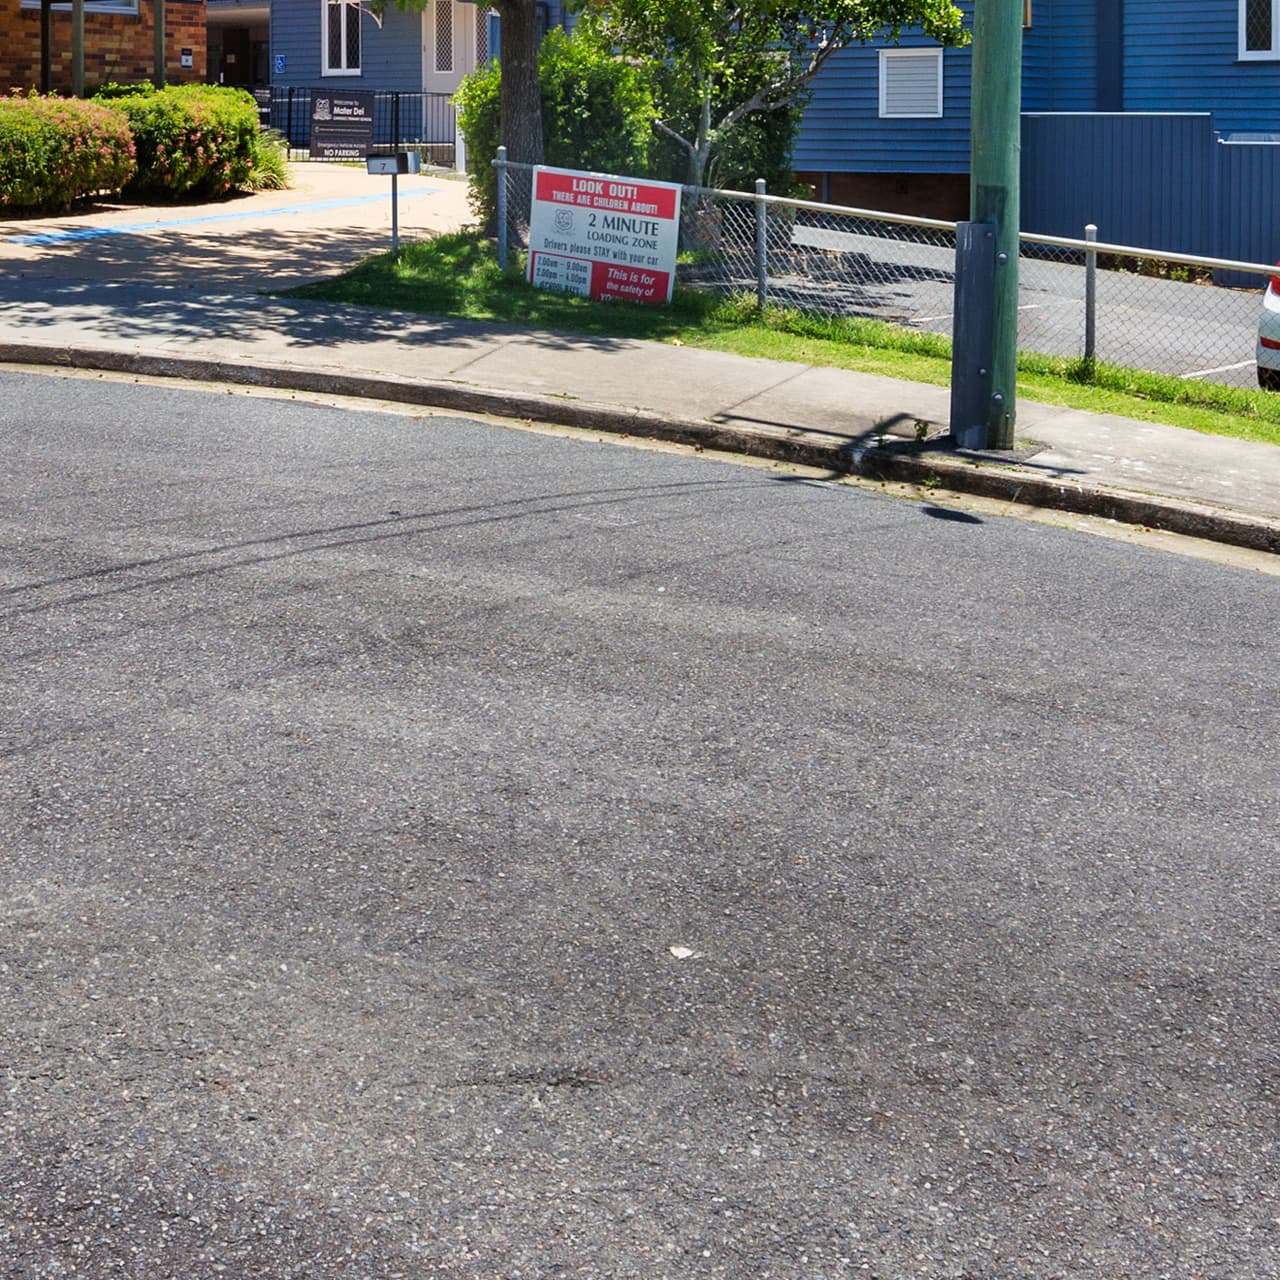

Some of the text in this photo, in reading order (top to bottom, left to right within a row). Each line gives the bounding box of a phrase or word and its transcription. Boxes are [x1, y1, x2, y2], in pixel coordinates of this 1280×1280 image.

[333, 106, 365, 116] Mater Dei
[324, 149, 360, 157] NO PARKING
[380, 163, 386, 171] 7
[572, 179, 638, 199] LOOK OUT!
[552, 190, 658, 215] THERE ARE CHILDREN ABOUT!
[588, 213, 659, 237] 2 MINUTE
[587, 230, 629, 246] LOADING
[631, 237, 658, 250] ZONE
[544, 238, 659, 266] Drivers please STAY with your car
[608, 268, 656, 286] This is for
[606, 281, 655, 297] the safety of
